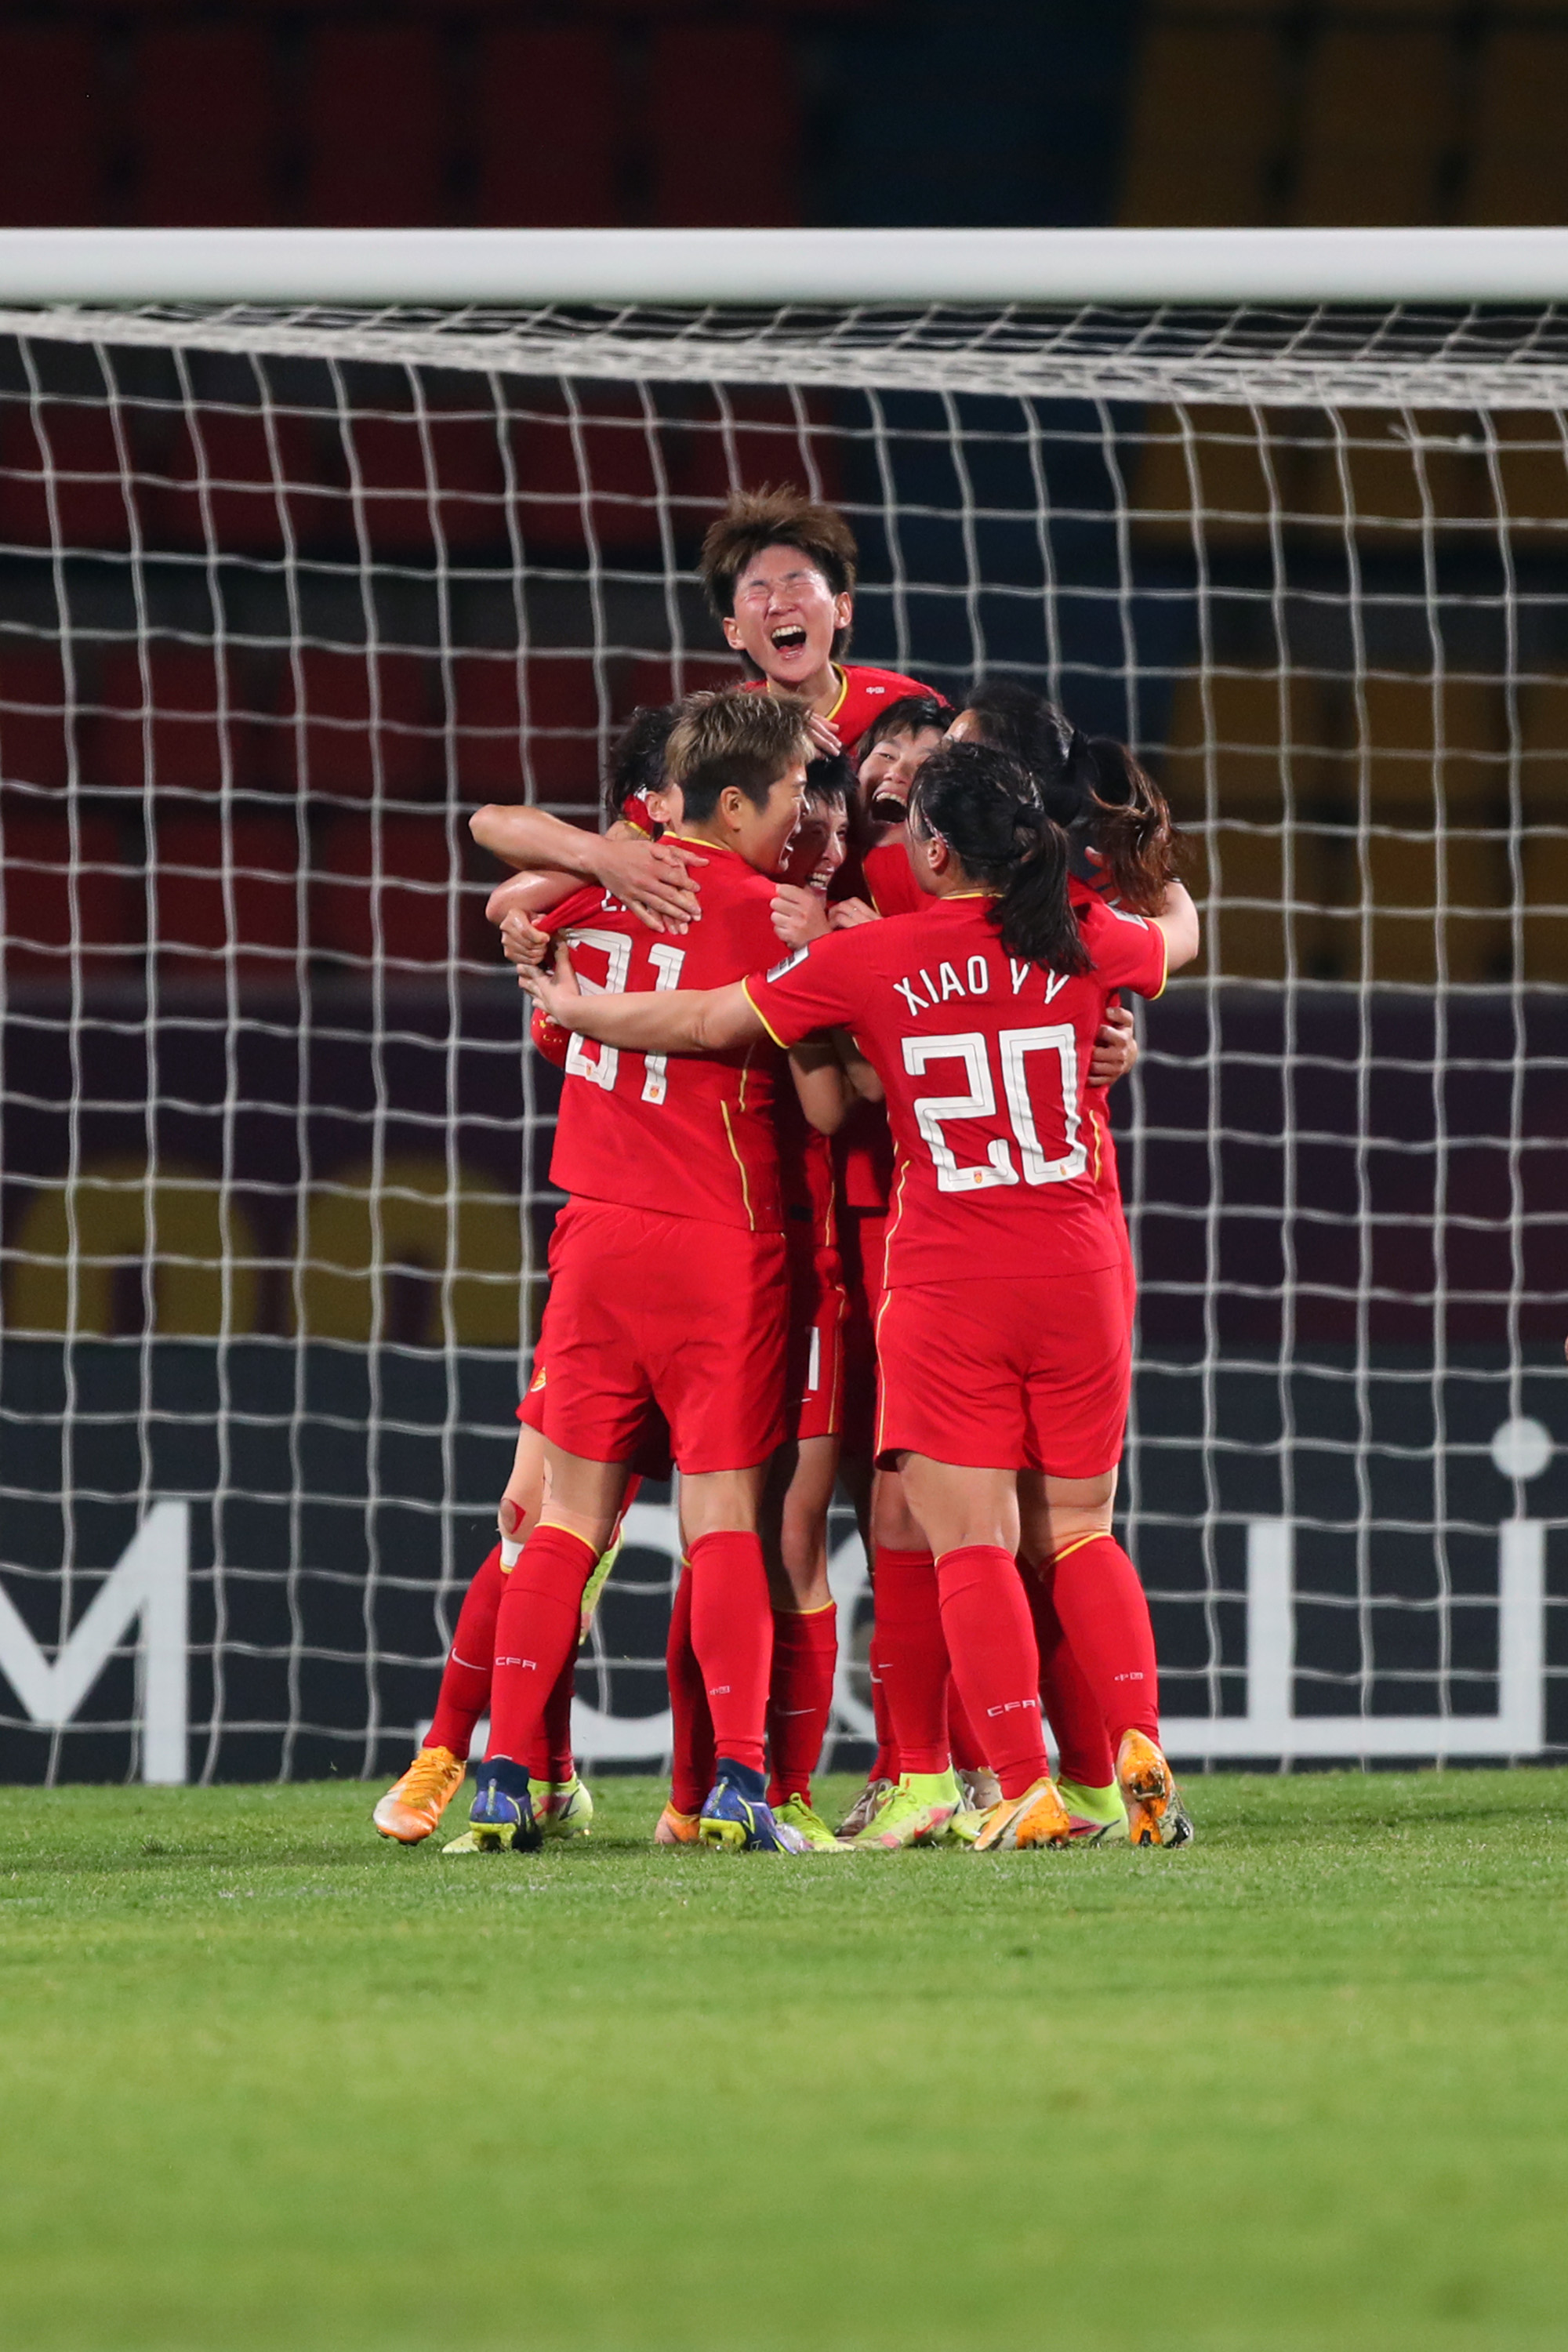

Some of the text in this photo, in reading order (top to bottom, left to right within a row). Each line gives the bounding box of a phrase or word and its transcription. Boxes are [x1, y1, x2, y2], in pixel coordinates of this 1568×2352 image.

[892, 954, 989, 1017] XIAO
[901, 1022, 1087, 1192] 20
[495, 1656, 537, 1671] CFA
[986, 1699, 1036, 1718] CFA
